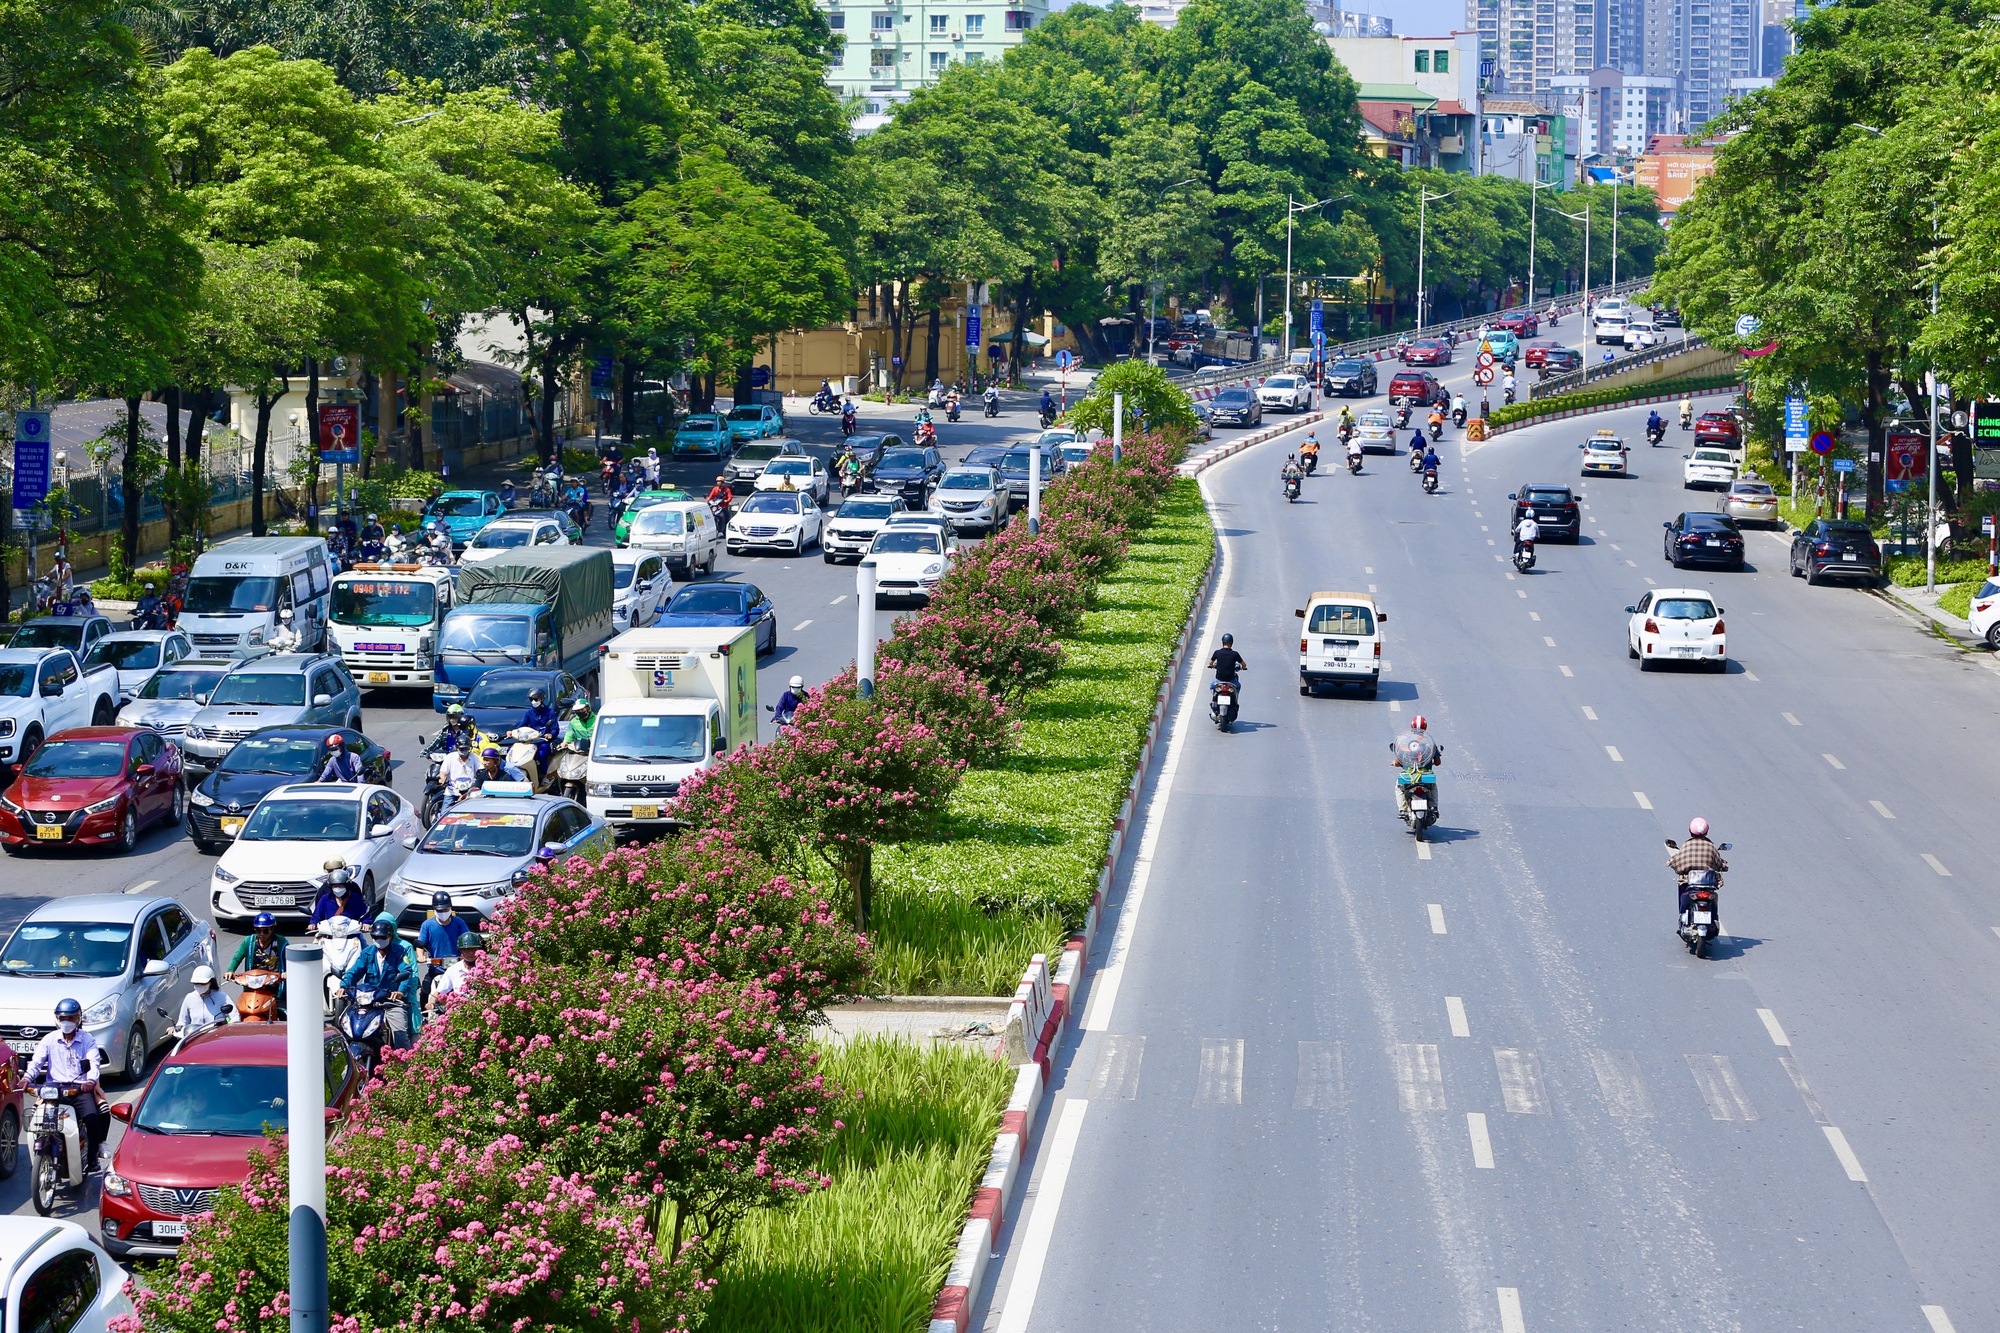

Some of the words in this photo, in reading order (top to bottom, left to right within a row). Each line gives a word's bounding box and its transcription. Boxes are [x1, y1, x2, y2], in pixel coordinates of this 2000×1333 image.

[1978, 417, 2000, 426] HÀNG
[353, 584, 374, 594] 0948
[376, 584, 392, 594] 112
[394, 585, 410, 594] 112
